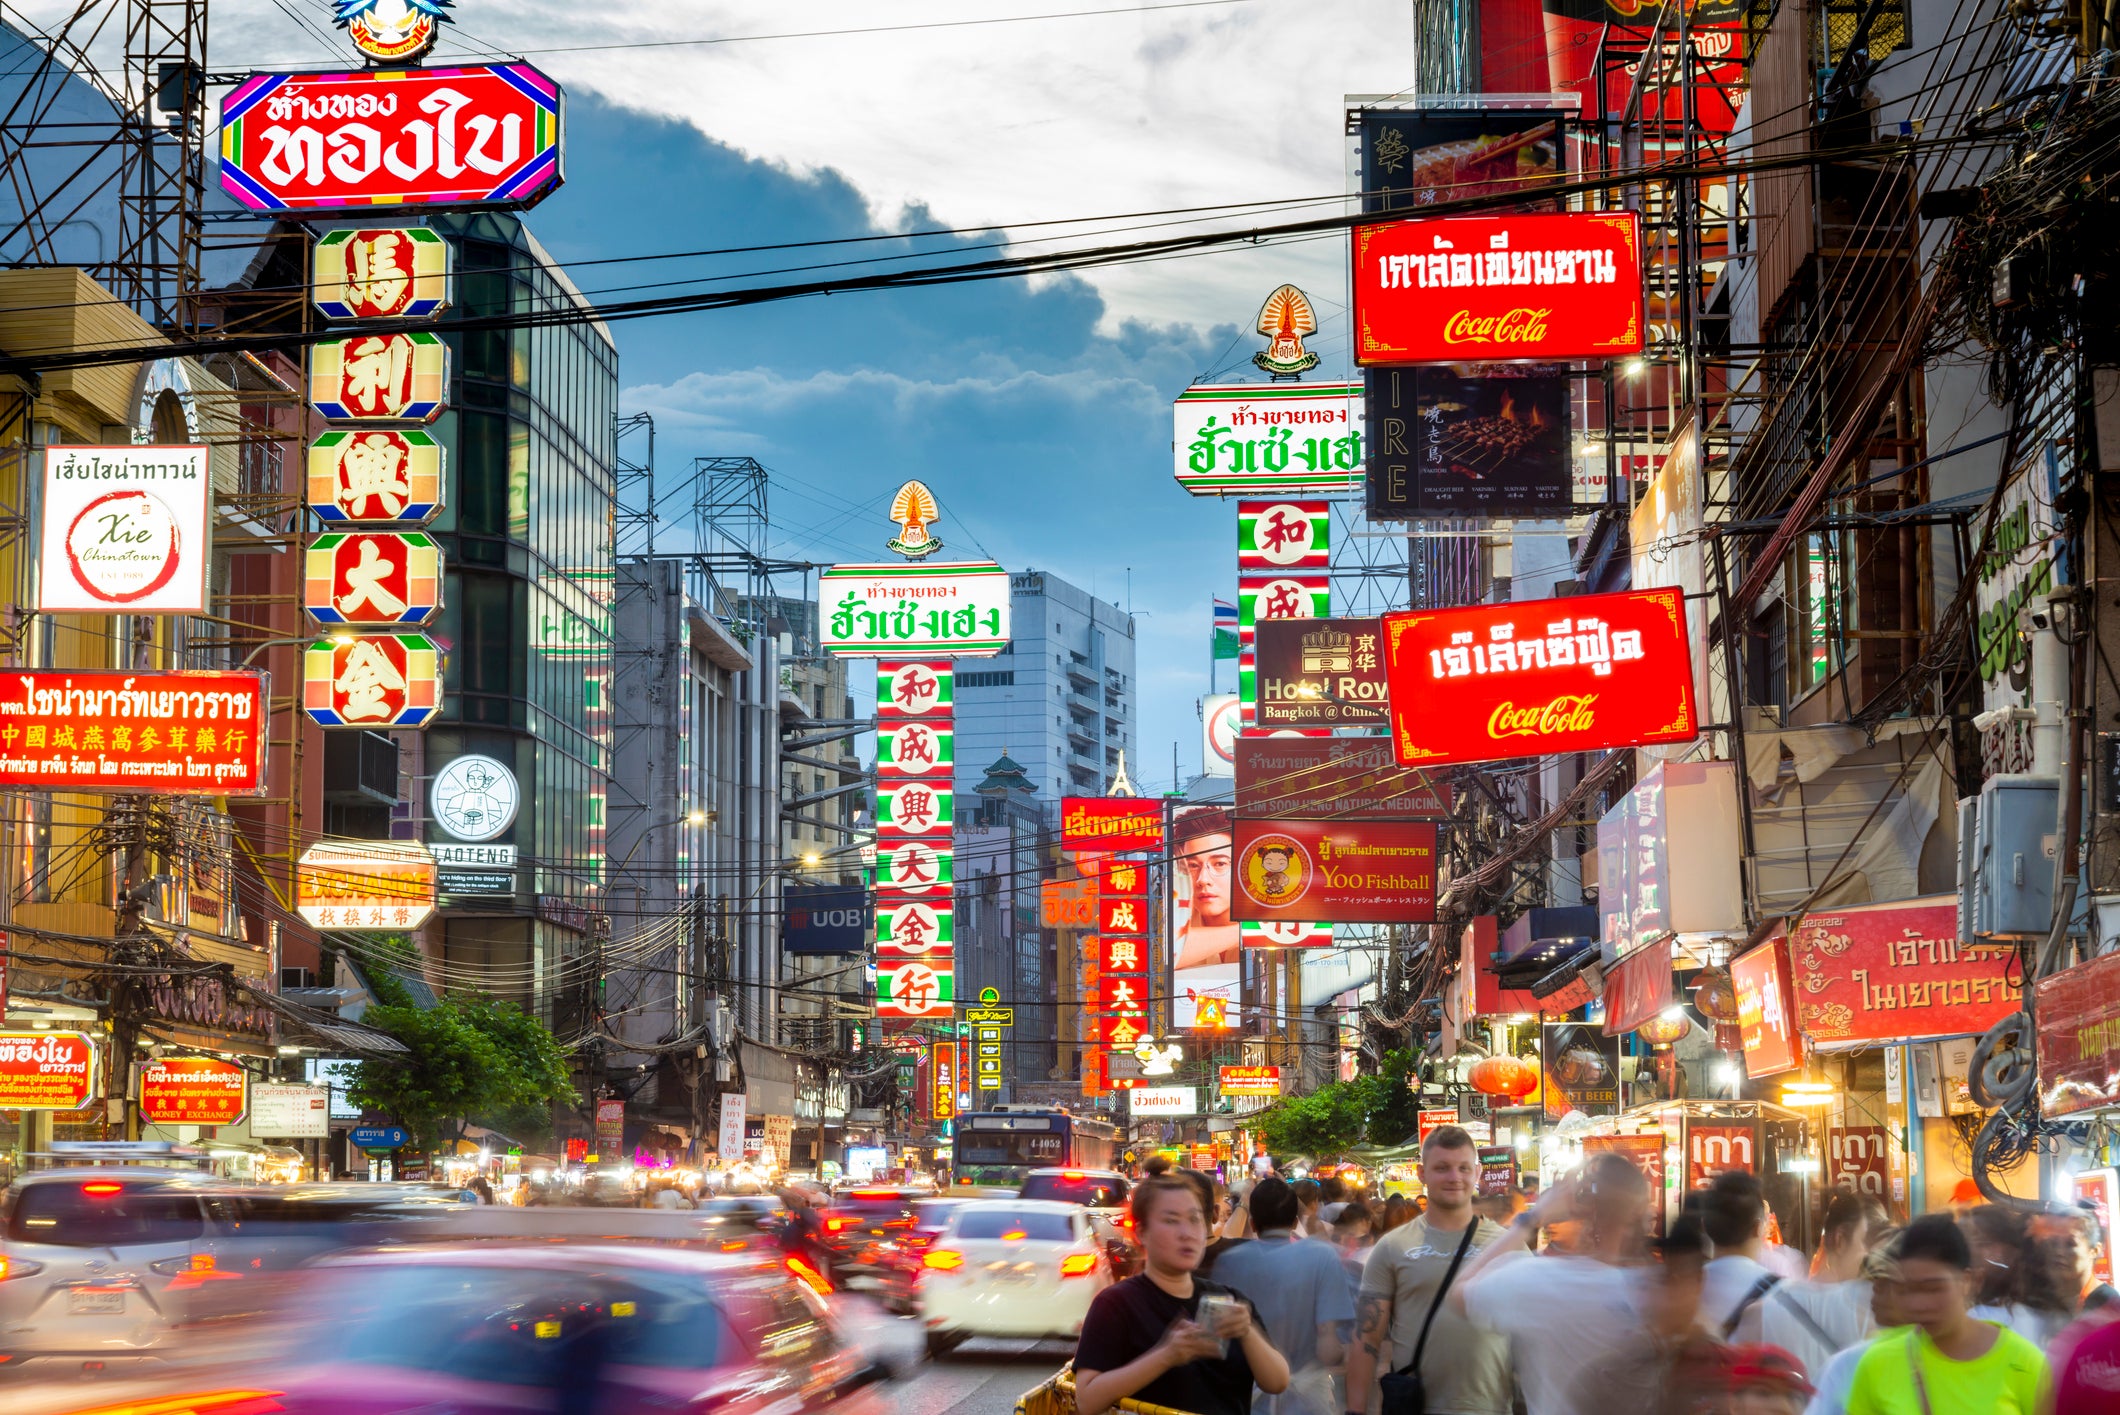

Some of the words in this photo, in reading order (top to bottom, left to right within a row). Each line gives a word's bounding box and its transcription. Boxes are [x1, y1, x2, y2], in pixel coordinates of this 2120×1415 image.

[267, 86, 397, 121] ห้างทอง
[260, 87, 523, 186] ทองใบ
[1379, 231, 1617, 288] เกาลัดเทียนซาน
[1443, 308, 1552, 344] Coca-Cola
[1231, 405, 1347, 426] ห้างขายทอง
[98, 513, 152, 544] Xie
[83, 547, 162, 562] Chinatown
[867, 582, 957, 598] ห้างขายทอง
[831, 591, 1000, 640] ฮั่วเซ่งเฮง
[1355, 634, 1376, 672] 京华
[20, 676, 252, 719] ไชน่ามาร์ทเยาวราช
[1264, 677, 1330, 700] Hotel
[1265, 706, 1321, 721] Bangkok
[1324, 706, 1338, 720] @
[1487, 693, 1600, 739] Coca-Cola
[98, 754, 118, 775] โสม
[1248, 753, 1321, 769] ร้านขายยา
[1248, 801, 1267, 812] LIM
[1269, 800, 1300, 812] SOON
[1302, 799, 1333, 811] HENG
[1335, 798, 1383, 811] NATURAL
[1386, 797, 1442, 810] MEDICINE
[299, 871, 429, 899] EXCHANGE
[1366, 874, 1429, 890] Fishball
[813, 909, 861, 927] UOB
[1586, 1091, 1617, 1101] BEER!
[151, 1110, 182, 1119] MONEY
[186, 1111, 233, 1119] EXCHANGE
[394, 1132, 401, 1142] 9
[1031, 1139, 1061, 1148] 4-4052
[1833, 1134, 1884, 1159] เกา
[1693, 1135, 1751, 1164] เกา
[1484, 1169, 1510, 1181] ส่งฟรี
